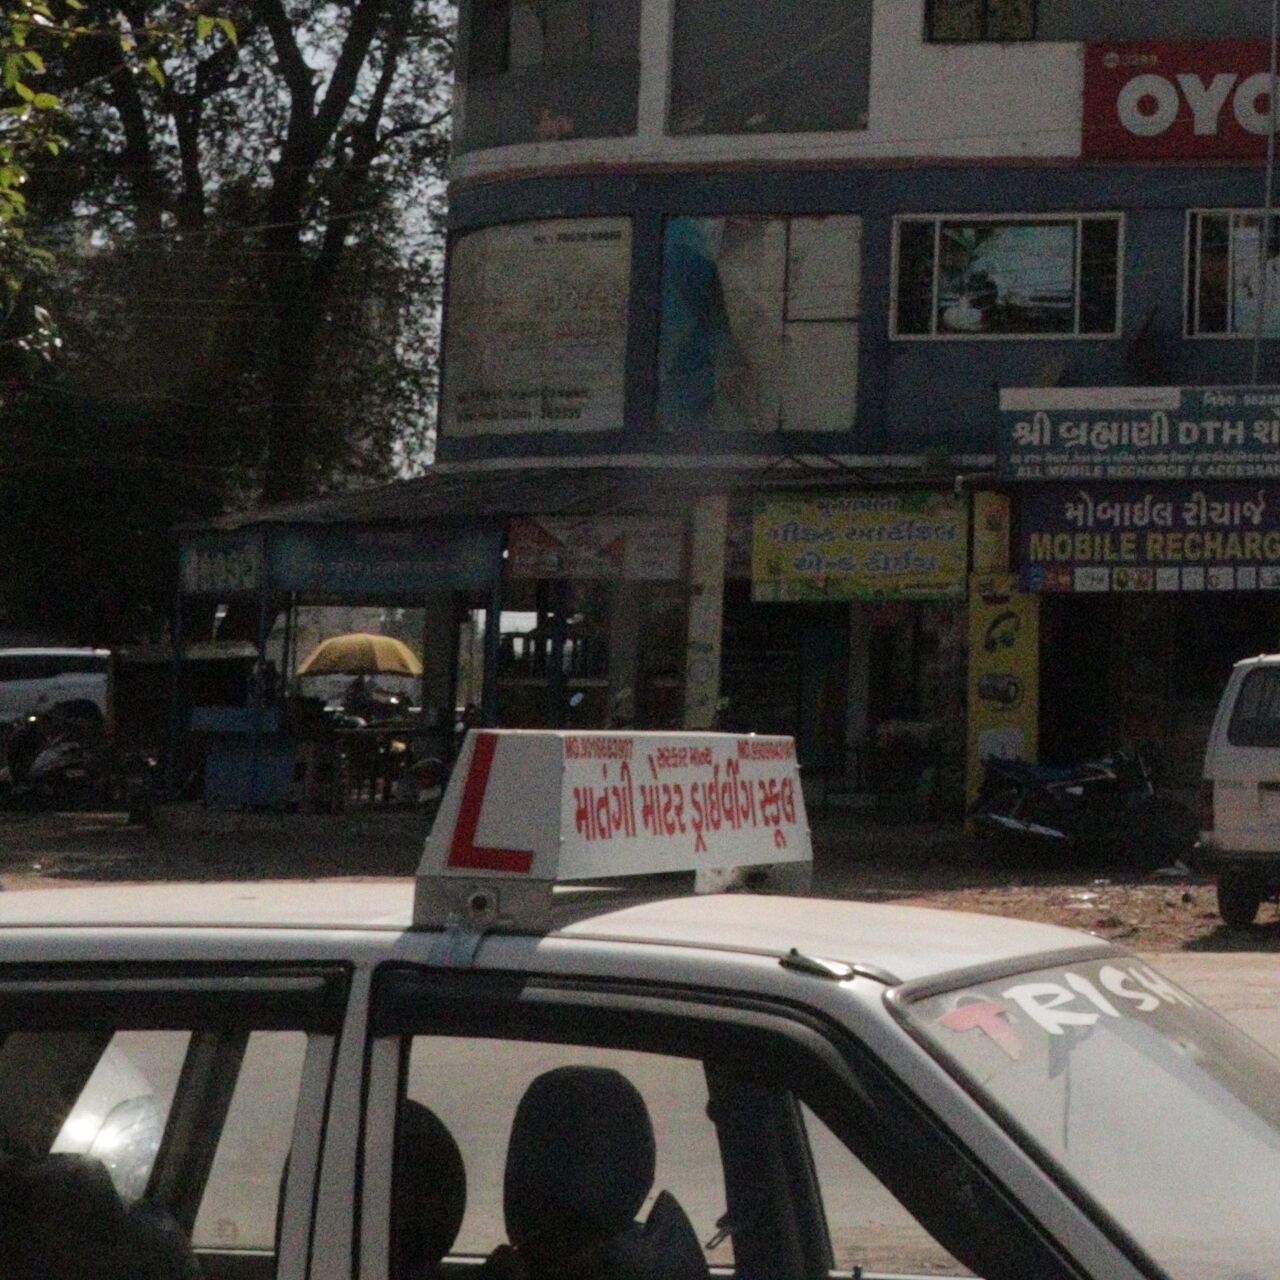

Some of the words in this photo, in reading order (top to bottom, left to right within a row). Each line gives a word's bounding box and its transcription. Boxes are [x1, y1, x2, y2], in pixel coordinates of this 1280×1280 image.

[1011, 410, 1052, 447] શ્રી
[1177, 420, 1245, 446] DTH
[1029, 531, 1137, 561] MOBILE
[447, 732, 534, 875] L
[639, 753, 687, 837] મોટર
[757, 777, 797, 849] સ્કૂલ
